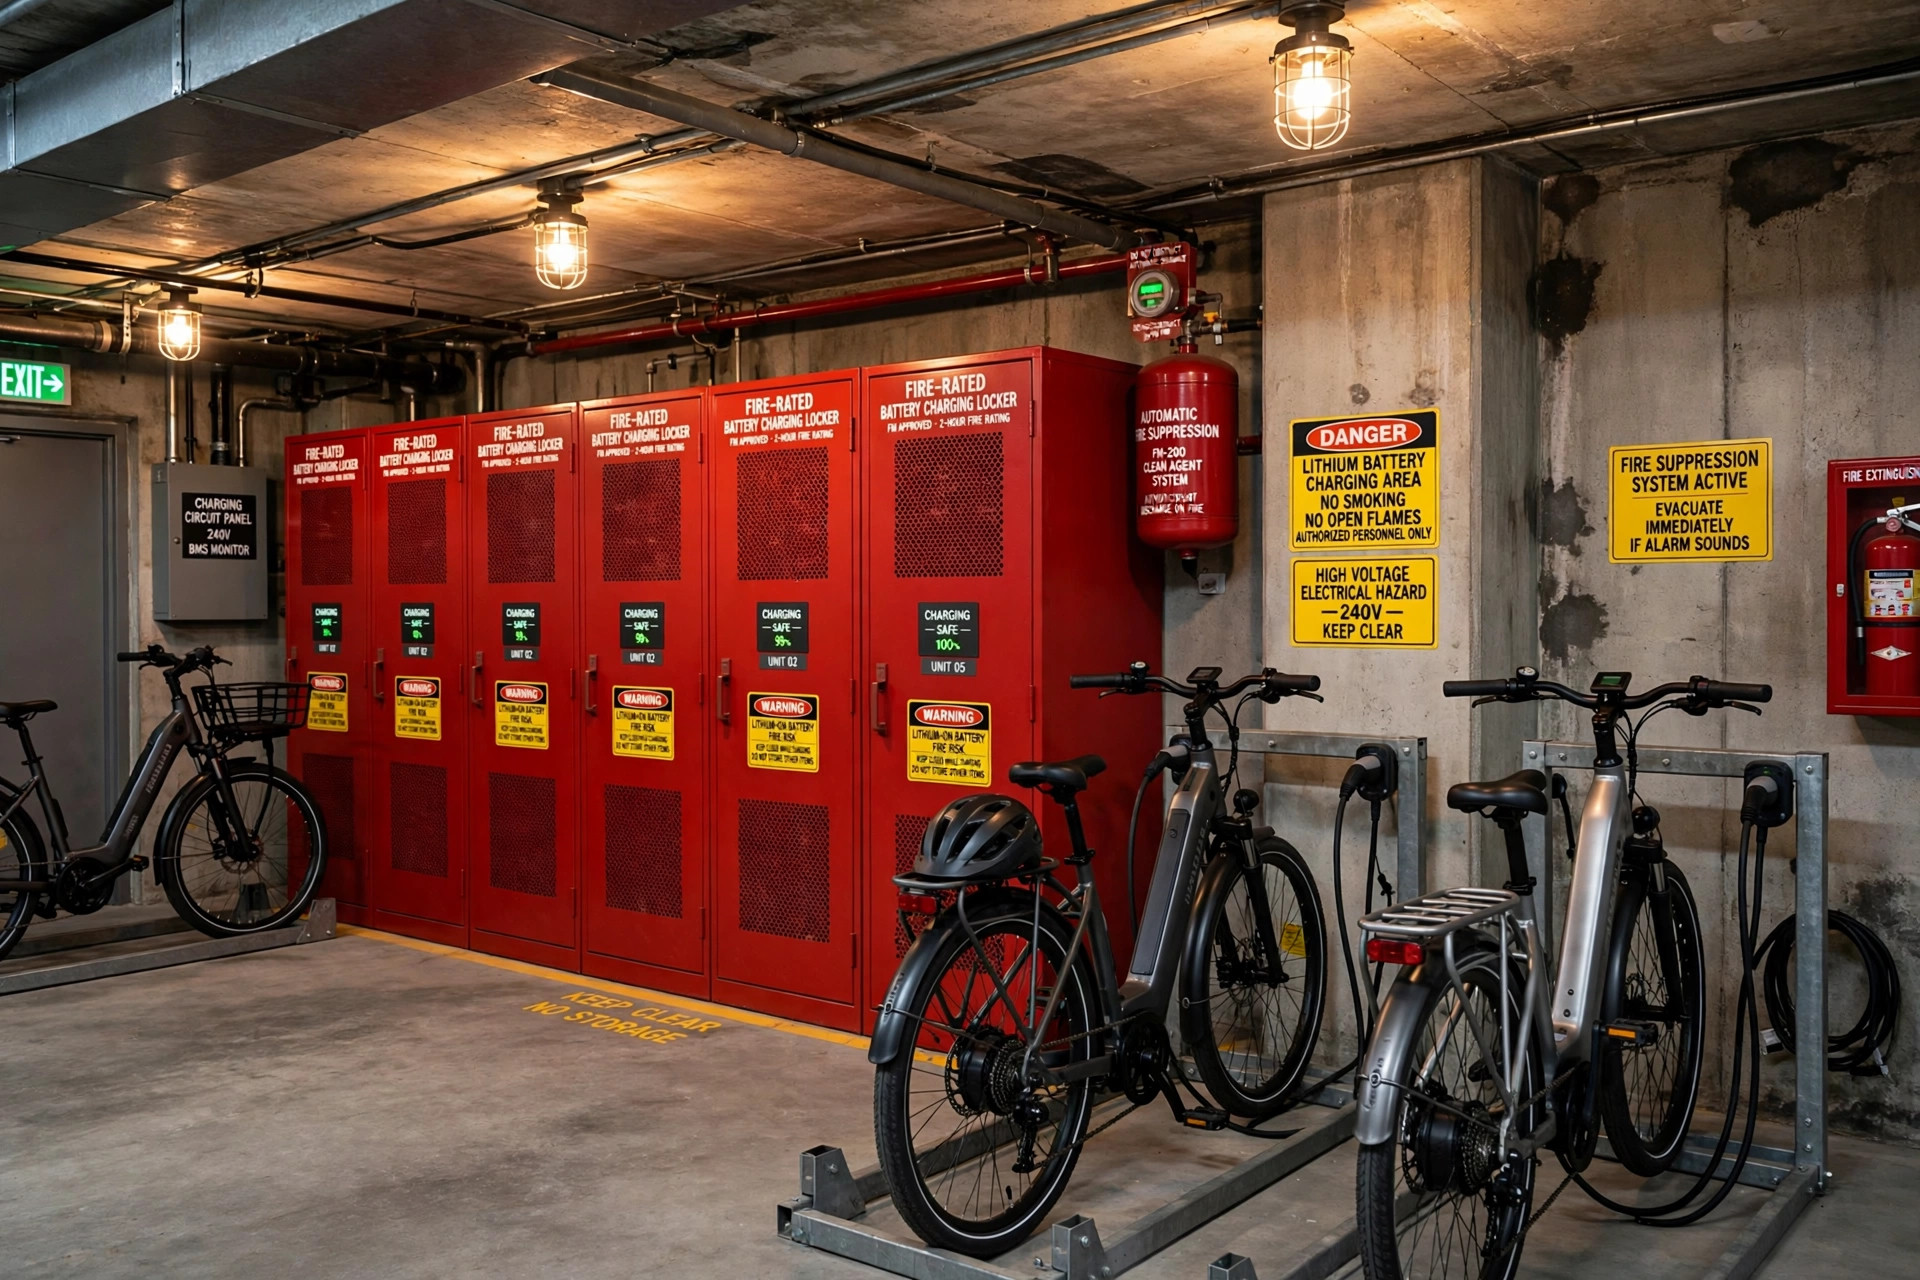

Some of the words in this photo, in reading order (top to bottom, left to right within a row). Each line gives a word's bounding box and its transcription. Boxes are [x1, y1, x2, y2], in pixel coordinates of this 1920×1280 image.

[1, 362, 45, 399] EXIT
[906, 373, 986, 399] FIRE-RATED
[746, 392, 813, 415] FIRE-RATED
[881, 402, 920, 420] BATTERY
[924, 396, 974, 416] CHARGING
[977, 391, 1017, 411] LOCKER
[610, 409, 668, 429] FIRE-RATED
[724, 418, 759, 434] BATTERY
[761, 414, 803, 431] CHARGING
[805, 410, 839, 427] LOCKER
[985, 413, 1010, 424] RATING
[1141, 407, 1198, 424] AUTOMATIC
[494, 422, 544, 442] FIRE-RATED
[592, 432, 622, 447] BATTERY
[624, 428, 660, 443] CHARGING
[661, 424, 690, 441] LOCKER
[1147, 424, 1219, 440] SUPPRESSION
[1320, 423, 1407, 447] DANGER
[394, 434, 437, 451] FIRE-RATED
[478, 443, 504, 457] BATTERY
[538, 437, 563, 452] LOCKER
[1152, 446, 1186, 459] FM-200
[1143, 460, 1167, 473] CLEAN
[1169, 459, 1202, 472] AGENT
[1302, 456, 1358, 474] LITHIUM
[1363, 452, 1426, 471] BATTERY
[1621, 455, 1652, 473] FIRE
[1655, 450, 1759, 472] SUPPRESSION
[1152, 473, 1188, 486] SYSTEM
[1306, 473, 1378, 491] CHARGING
[1383, 471, 1421, 488] AREA
[1632, 474, 1689, 493] SYSTEM
[1694, 471, 1748, 490] ACTIVE
[1842, 470, 1863, 483] FIRE
[194, 497, 243, 511] CHARGING
[1320, 494, 1339, 510] NO
[1343, 492, 1405, 509] SMOKING
[1655, 500, 1724, 517] EVACUATE
[185, 511, 222, 524] CIRCUIT
[224, 512, 252, 525] PANEL
[1305, 512, 1323, 528] NO
[1328, 511, 1363, 527] OPEN
[1367, 508, 1421, 526] FLAMES
[1645, 517, 1733, 535] IMMEDIATELY
[207, 528, 231, 540] 240V
[1296, 529, 1350, 543] AUTHORIZED
[1353, 528, 1406, 541] PERSONNEL
[1408, 526, 1432, 540] ONLY
[188, 543, 208, 555] BMS
[211, 544, 250, 555] MONITOR
[1630, 537, 1641, 552] IF
[1645, 536, 1690, 552] ALARM
[1694, 535, 1750, 551] SOUNDS
[1316, 567, 1347, 583] HIGH
[1352, 565, 1410, 582] VOLTAGE
[1301, 584, 1371, 600] ELECTRICAL
[1376, 584, 1427, 600] HAZARD
[506, 609, 535, 618] CHARGING
[624, 609, 659, 619] CHARGING
[762, 609, 801, 619] CHARGING
[924, 610, 971, 621] CHARGING
[1340, 603, 1382, 620] 240V
[513, 620, 527, 629] SAFE
[633, 622, 649, 630] SAFE
[772, 622, 791, 632] SAFE
[936, 624, 958, 635] SAFE
[1323, 623, 1355, 639] KEEP
[1360, 623, 1403, 639] CLEAR
[511, 650, 524, 658] UNIT
[629, 653, 645, 663] UNIT
[646, 653, 655, 663] 02
[768, 656, 786, 667] UNIT
[787, 656, 798, 667] 02
[931, 661, 951, 673] UNIT
[954, 661, 966, 673] 05
[624, 693, 662, 705] WARNING
[761, 700, 805, 714] WARNING
[923, 709, 974, 723] WARNING
[955, 731, 985, 744] BATTERY
[932, 743, 947, 753] FIRE
[560, 991, 633, 1009] KEEP
[631, 1007, 722, 1032] CLEAR
[522, 1001, 571, 1015] NO
[563, 1011, 689, 1044] STORAGE
